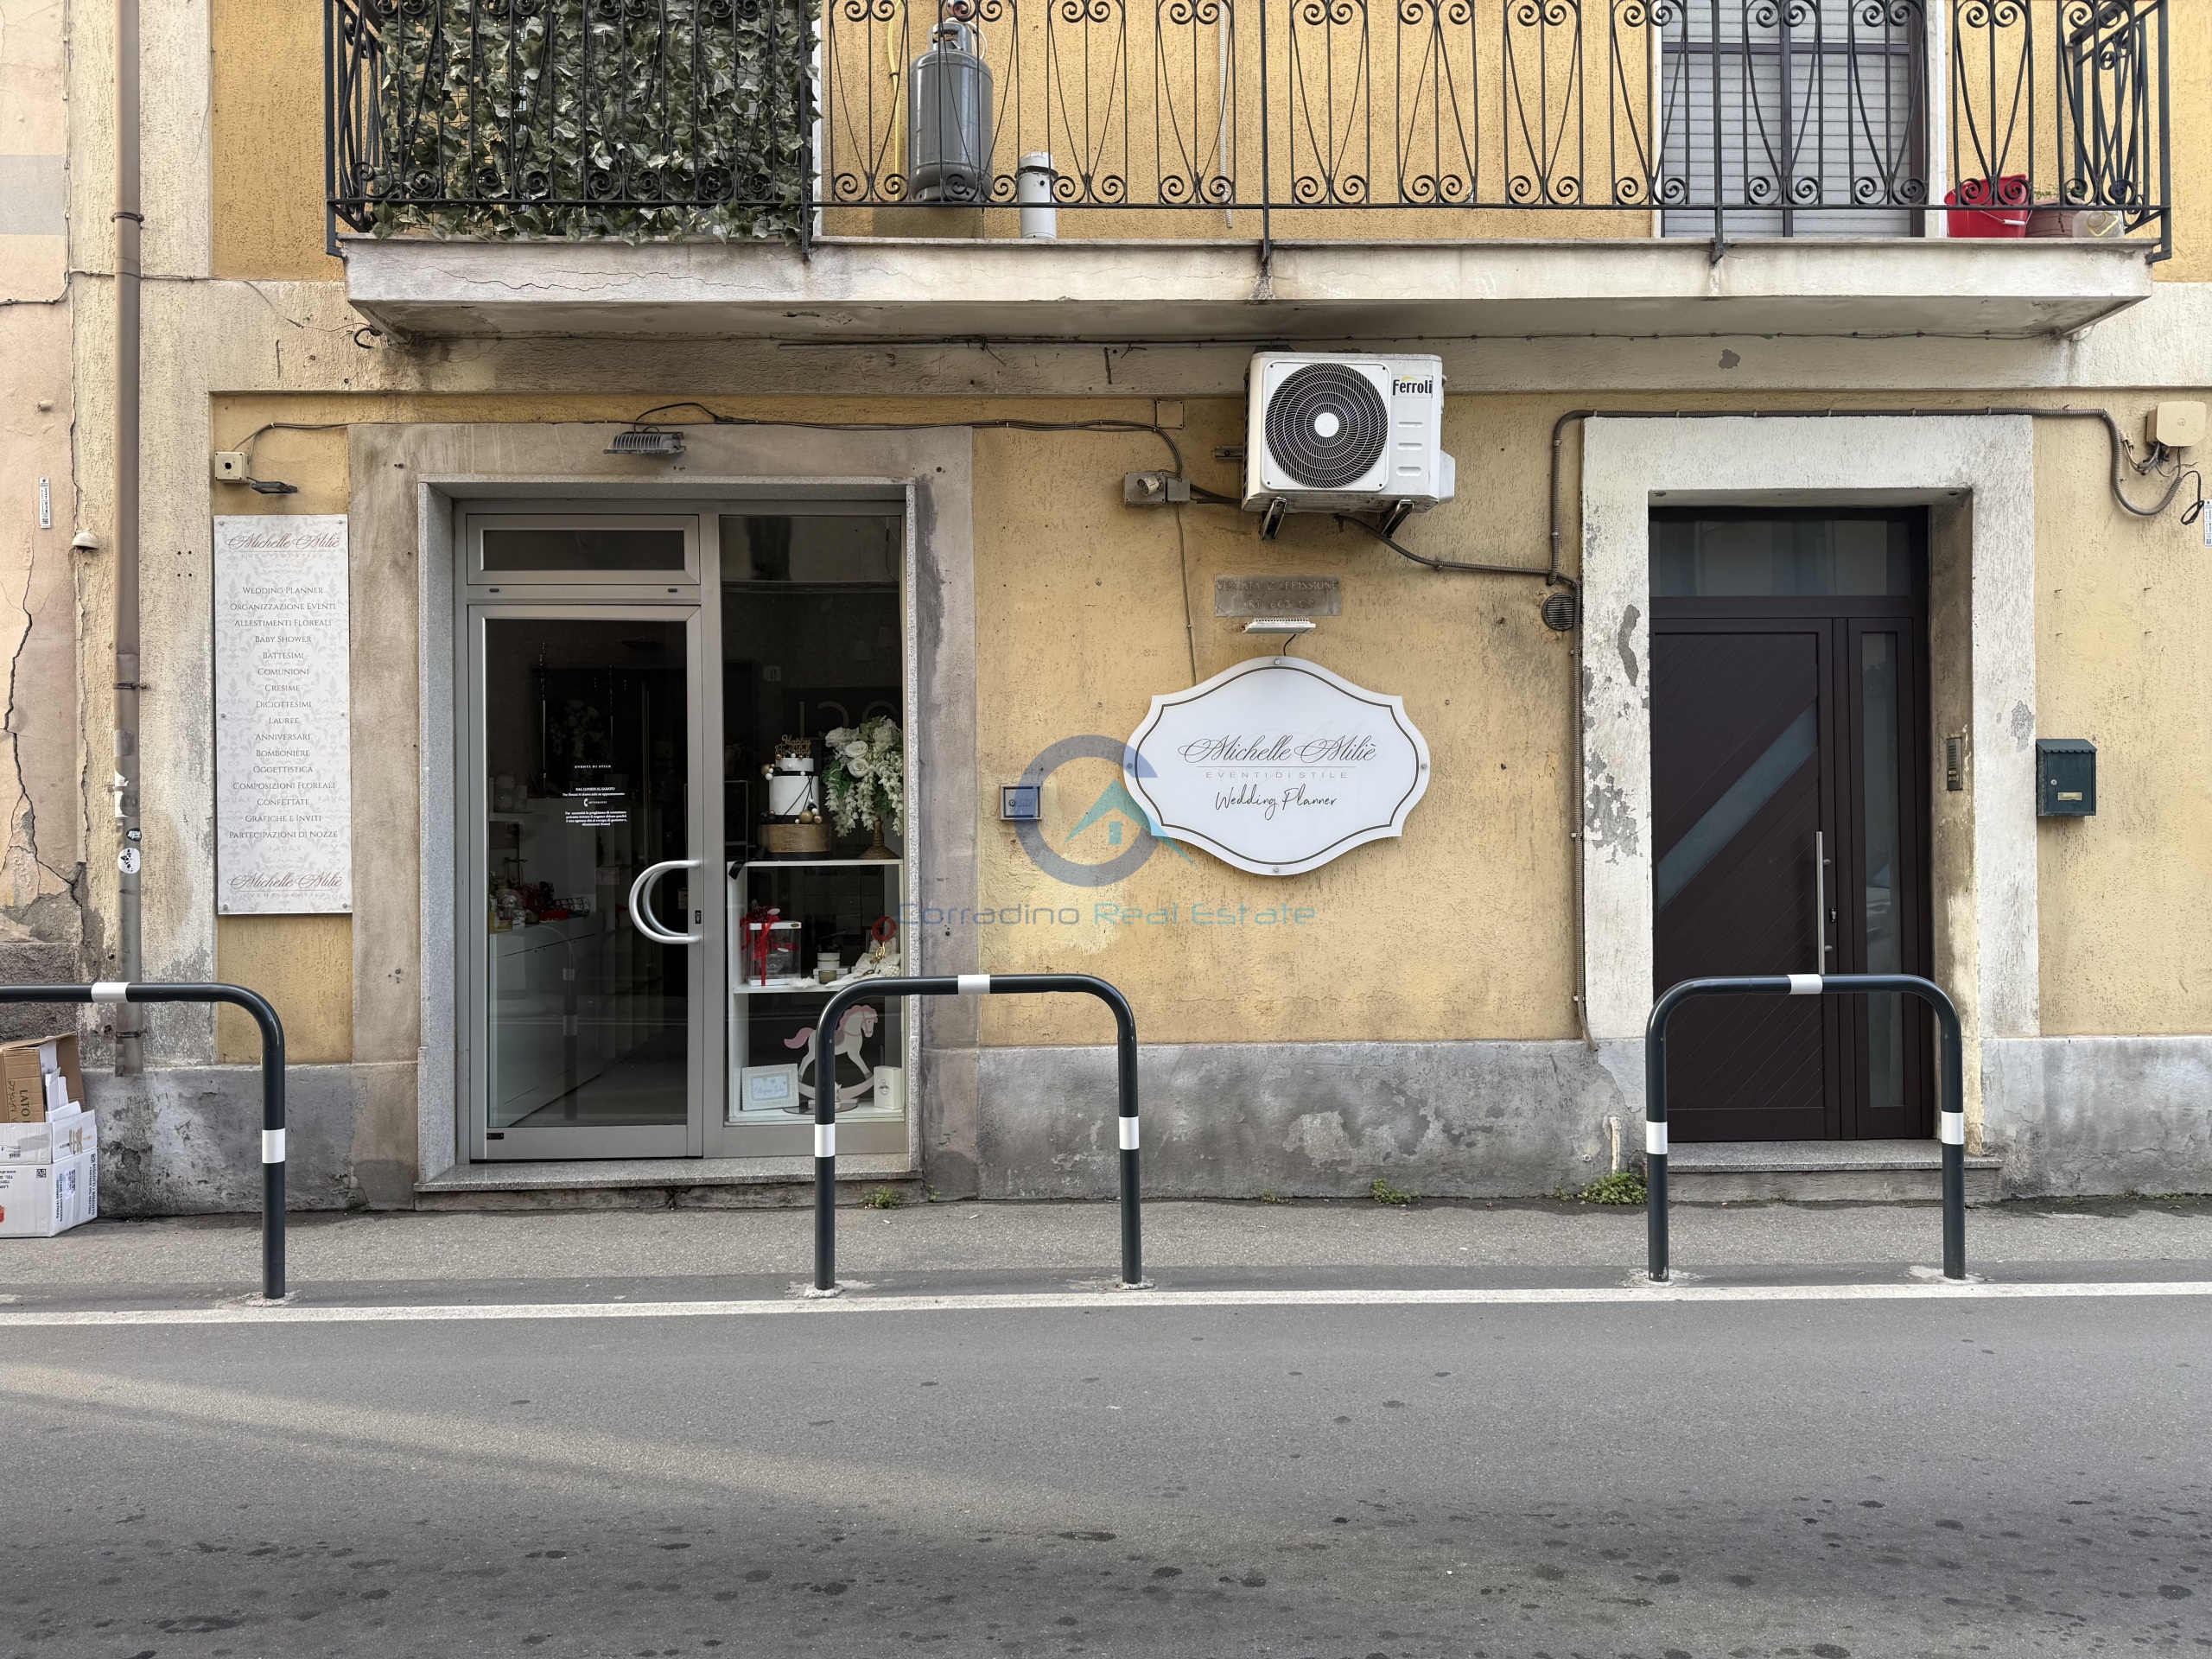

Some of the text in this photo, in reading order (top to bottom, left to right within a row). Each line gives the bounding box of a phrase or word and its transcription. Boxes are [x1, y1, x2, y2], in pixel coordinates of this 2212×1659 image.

[1392, 378, 1433, 396] Ferroli
[225, 532, 291, 550] Michelle
[242, 586, 323, 594] WEDDING PLANNER
[229, 602, 305, 611] ORGANIZZAZIONE
[234, 619, 292, 627] ALLESTIMENTI
[264, 683, 301, 692] CRESIME
[256, 700, 312, 709] DICIOTTESIMI
[1177, 734, 1376, 763] Michelle Miliè
[297, 781, 335, 790] FLOREALI
[1215, 783, 1338, 821] Wedding Planner
[226, 872, 294, 890] Michelle
[19, 1090, 30, 1117] LATO
